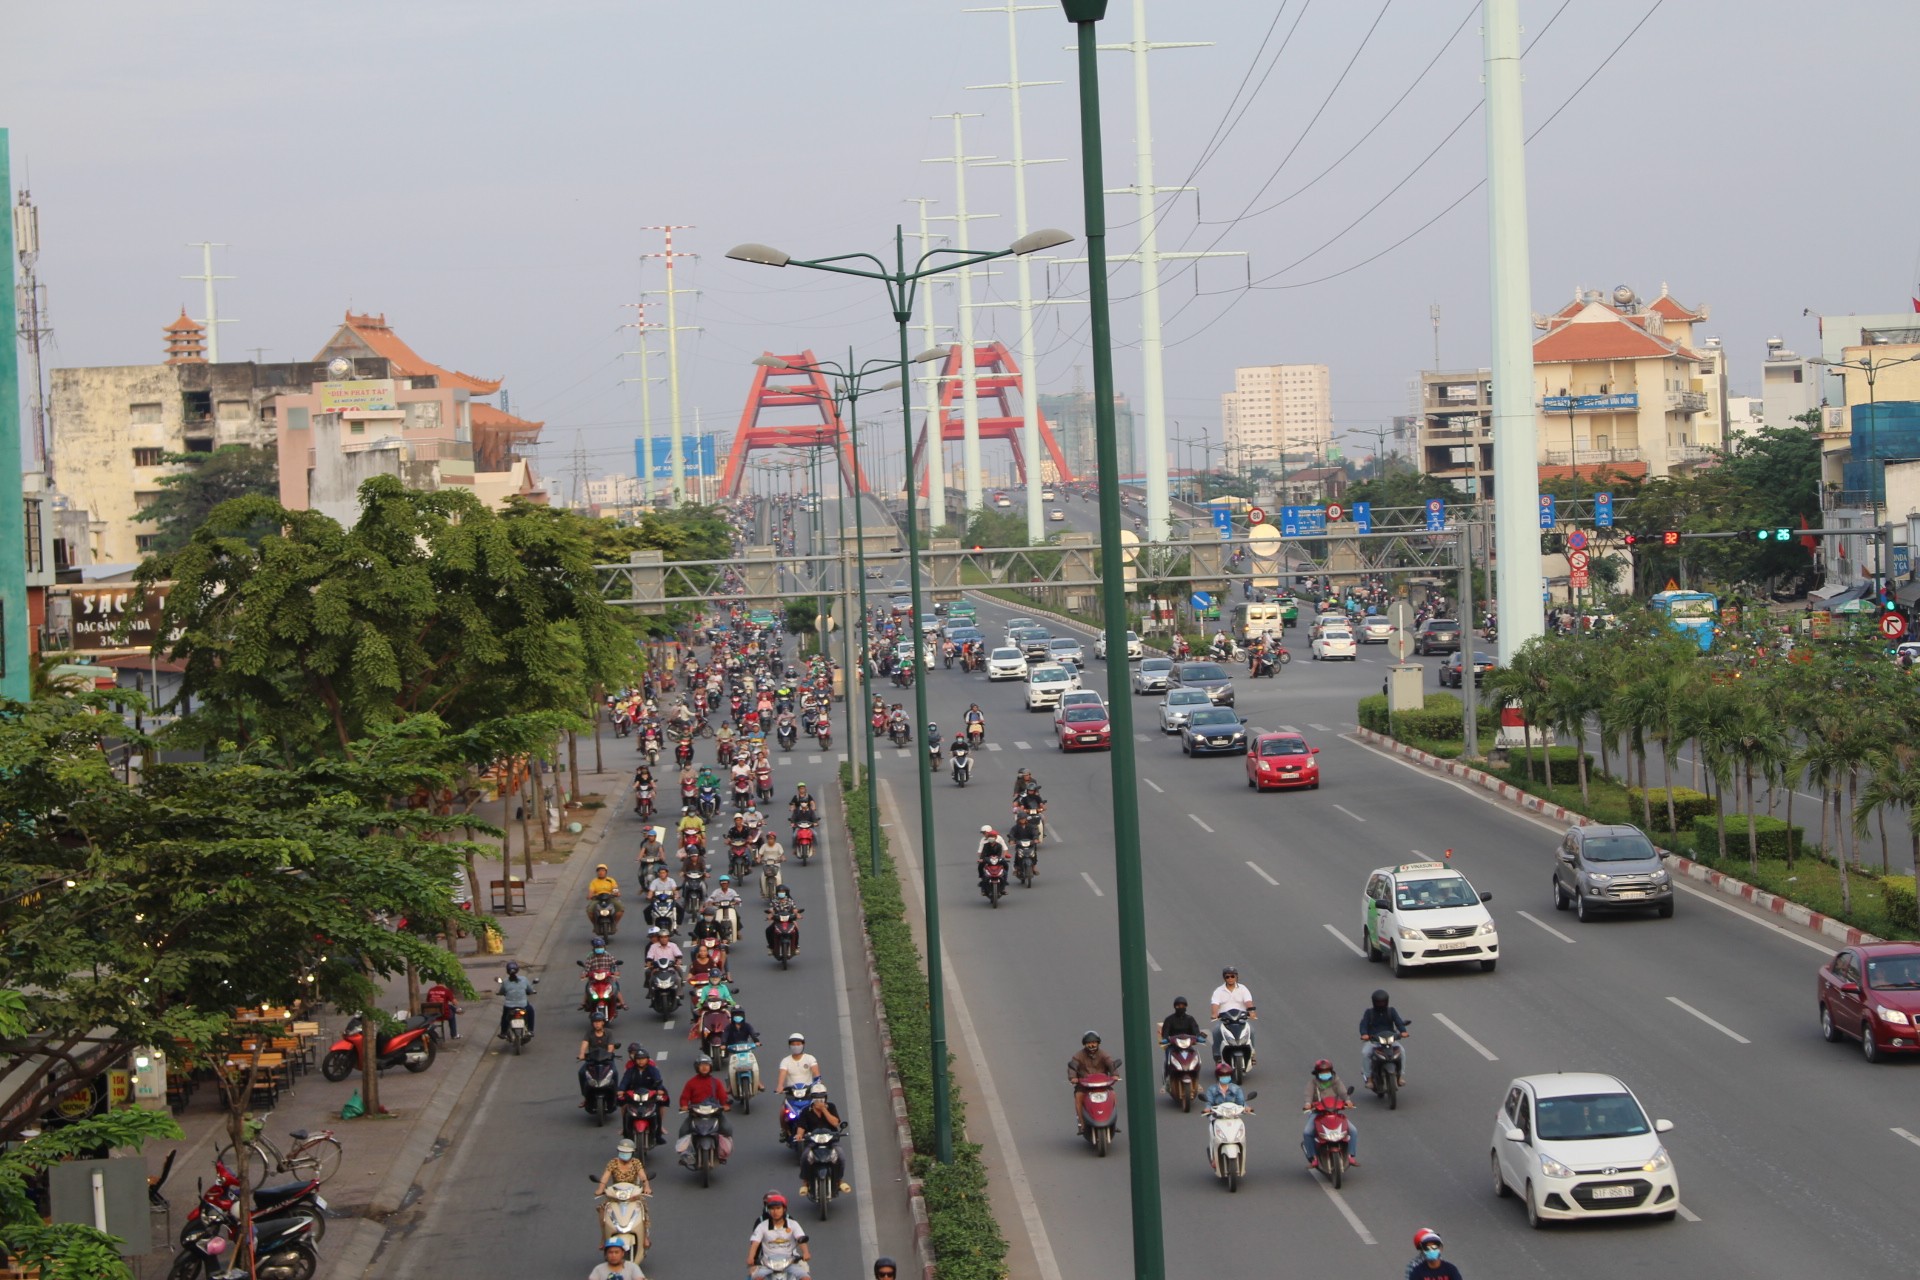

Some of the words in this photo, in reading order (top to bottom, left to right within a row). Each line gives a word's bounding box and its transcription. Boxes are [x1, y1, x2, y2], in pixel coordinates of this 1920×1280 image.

[1253, 511, 1260, 520] 80
[1664, 532, 1678, 544] 32
[1776, 528, 1790, 541] 26
[100, 635, 107, 647] 3
